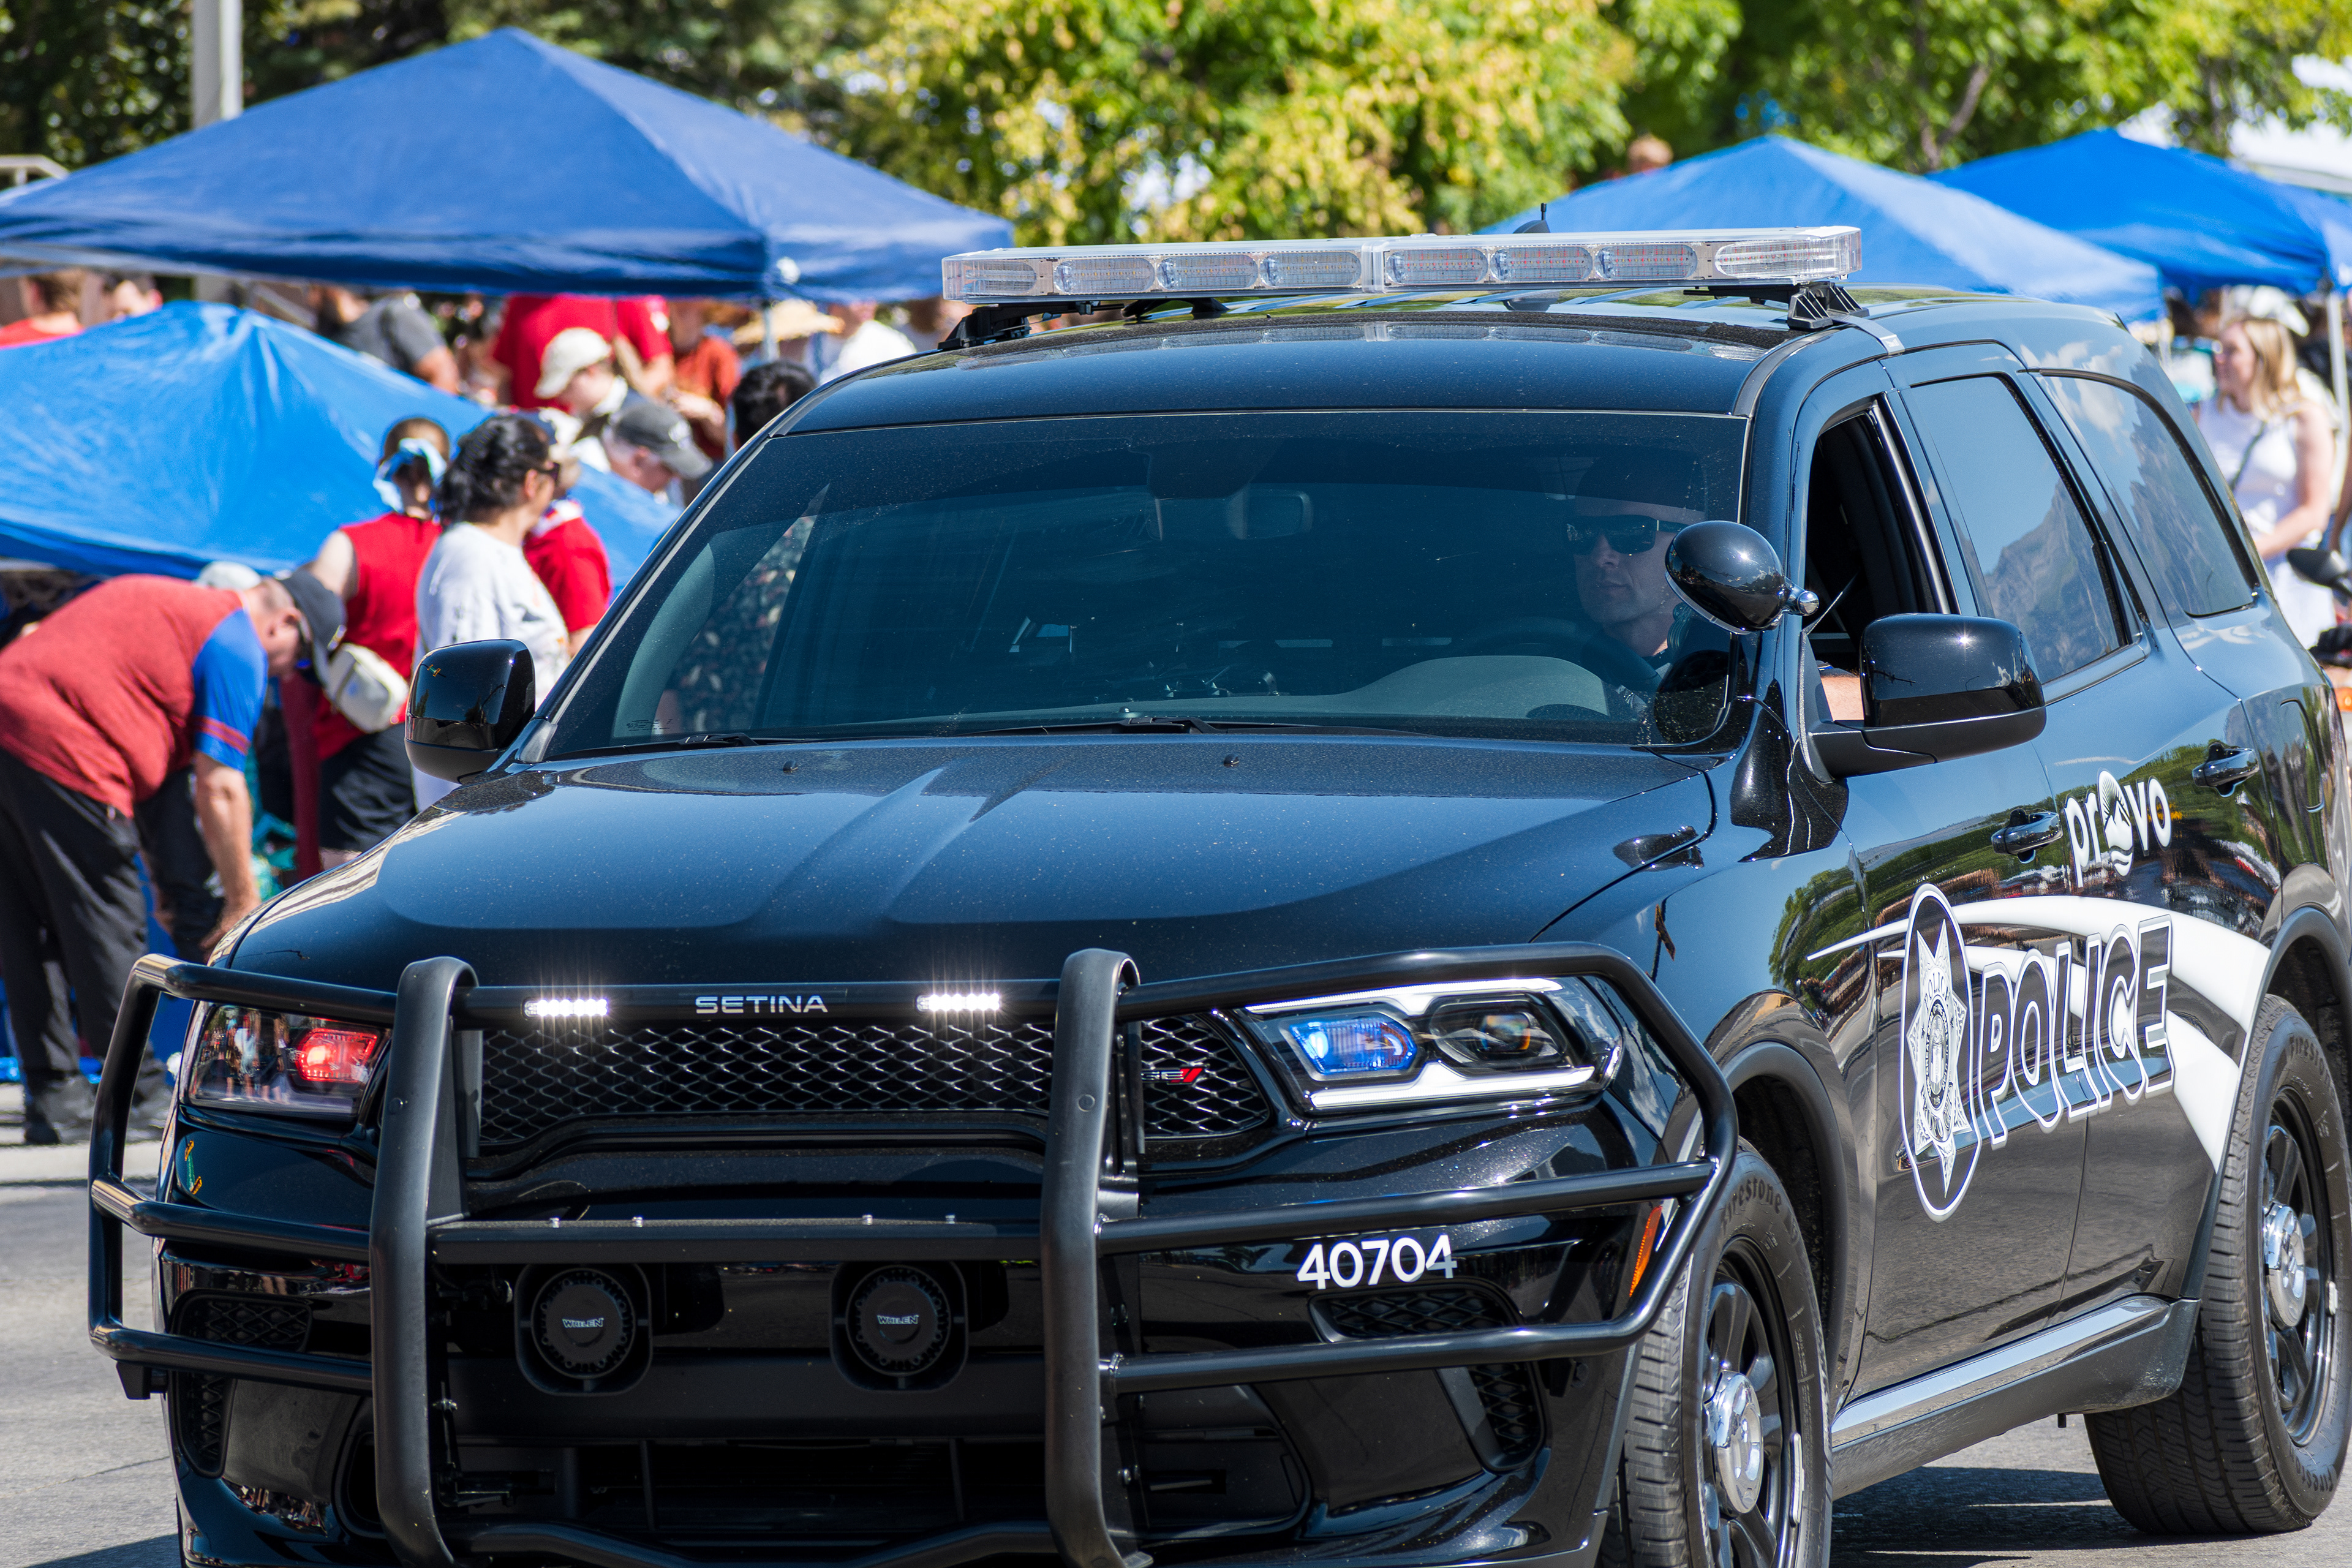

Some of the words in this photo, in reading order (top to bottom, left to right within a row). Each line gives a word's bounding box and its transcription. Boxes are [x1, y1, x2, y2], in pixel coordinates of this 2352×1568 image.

[695, 995, 828, 1014] SETINA
[1924, 971, 1950, 1012] POLICE
[1978, 913, 2175, 1149] POLICE
[1297, 1234, 1458, 1290] 40704
